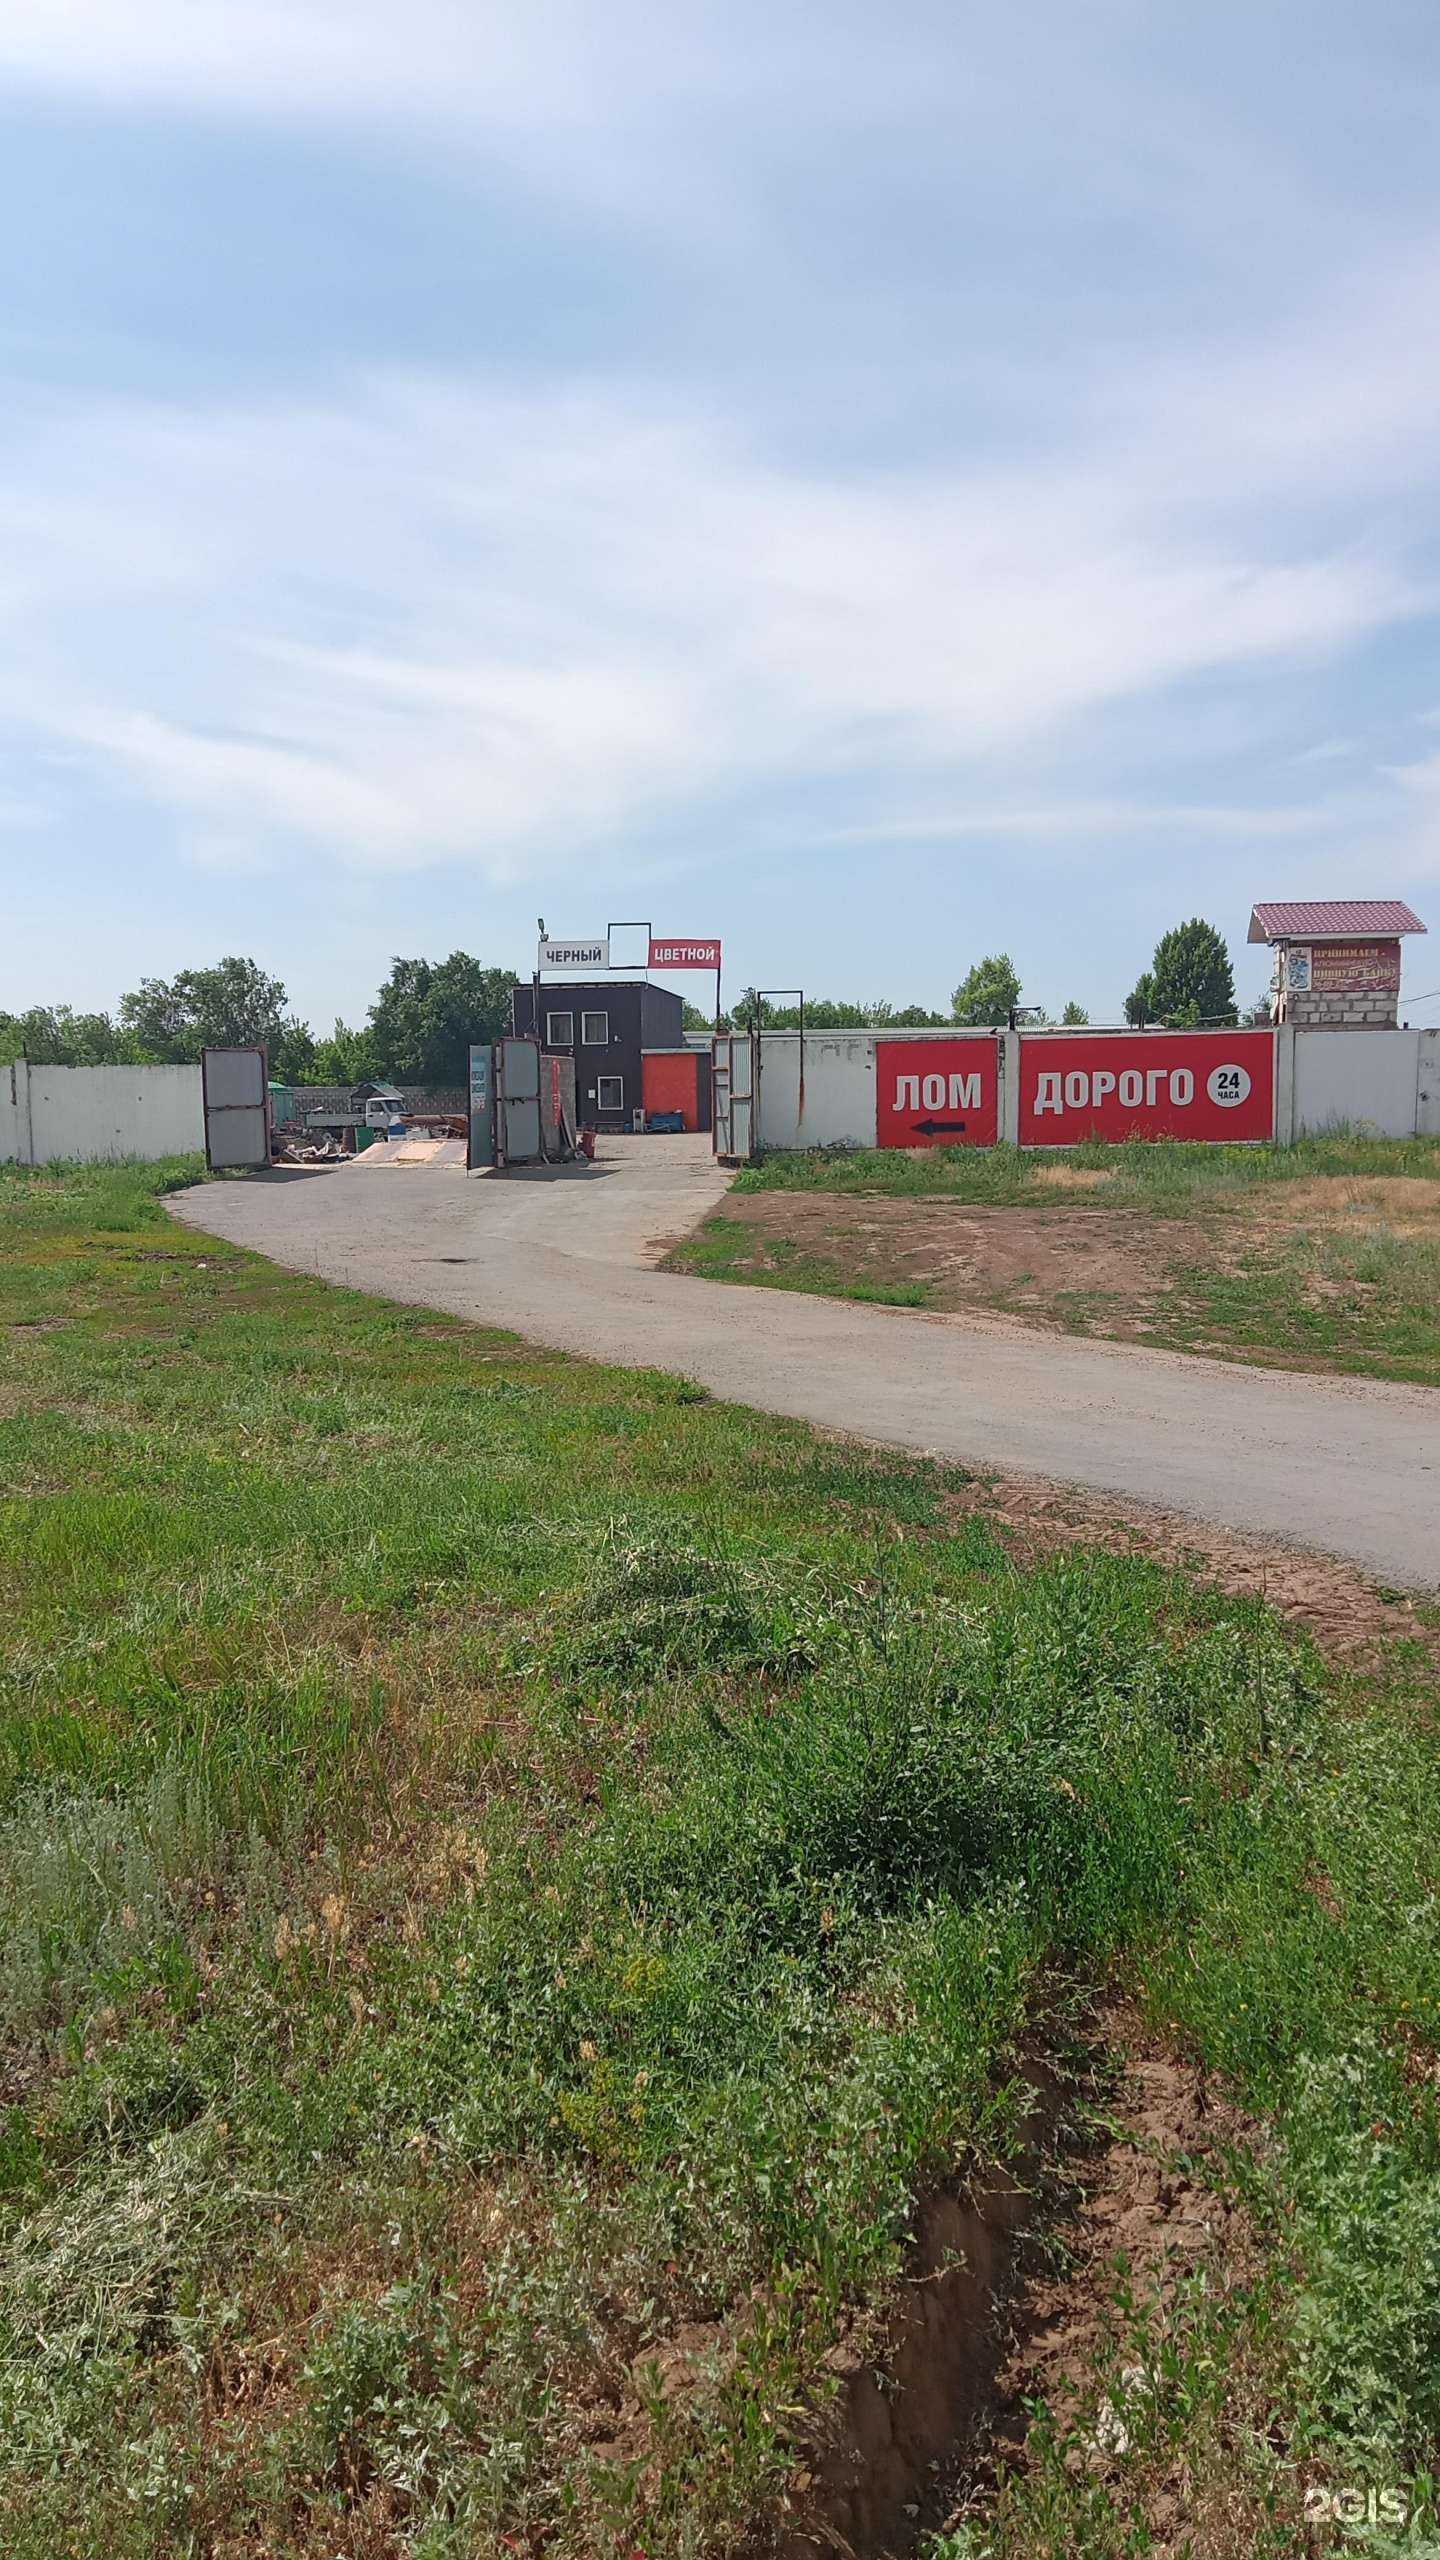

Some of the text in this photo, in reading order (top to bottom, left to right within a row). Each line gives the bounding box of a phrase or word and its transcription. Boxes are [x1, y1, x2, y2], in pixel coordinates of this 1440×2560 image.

[546, 947, 601, 963] ЧЕРНЫЙ
[654, 946, 715, 963] ЦВЕТНОЙ
[1217, 1072, 1241, 1090] 24
[892, 1073, 983, 1111] ЛОМ
[1033, 1068, 1195, 1116] ДОРОГО
[1217, 1090, 1241, 1100] ЧАСА
